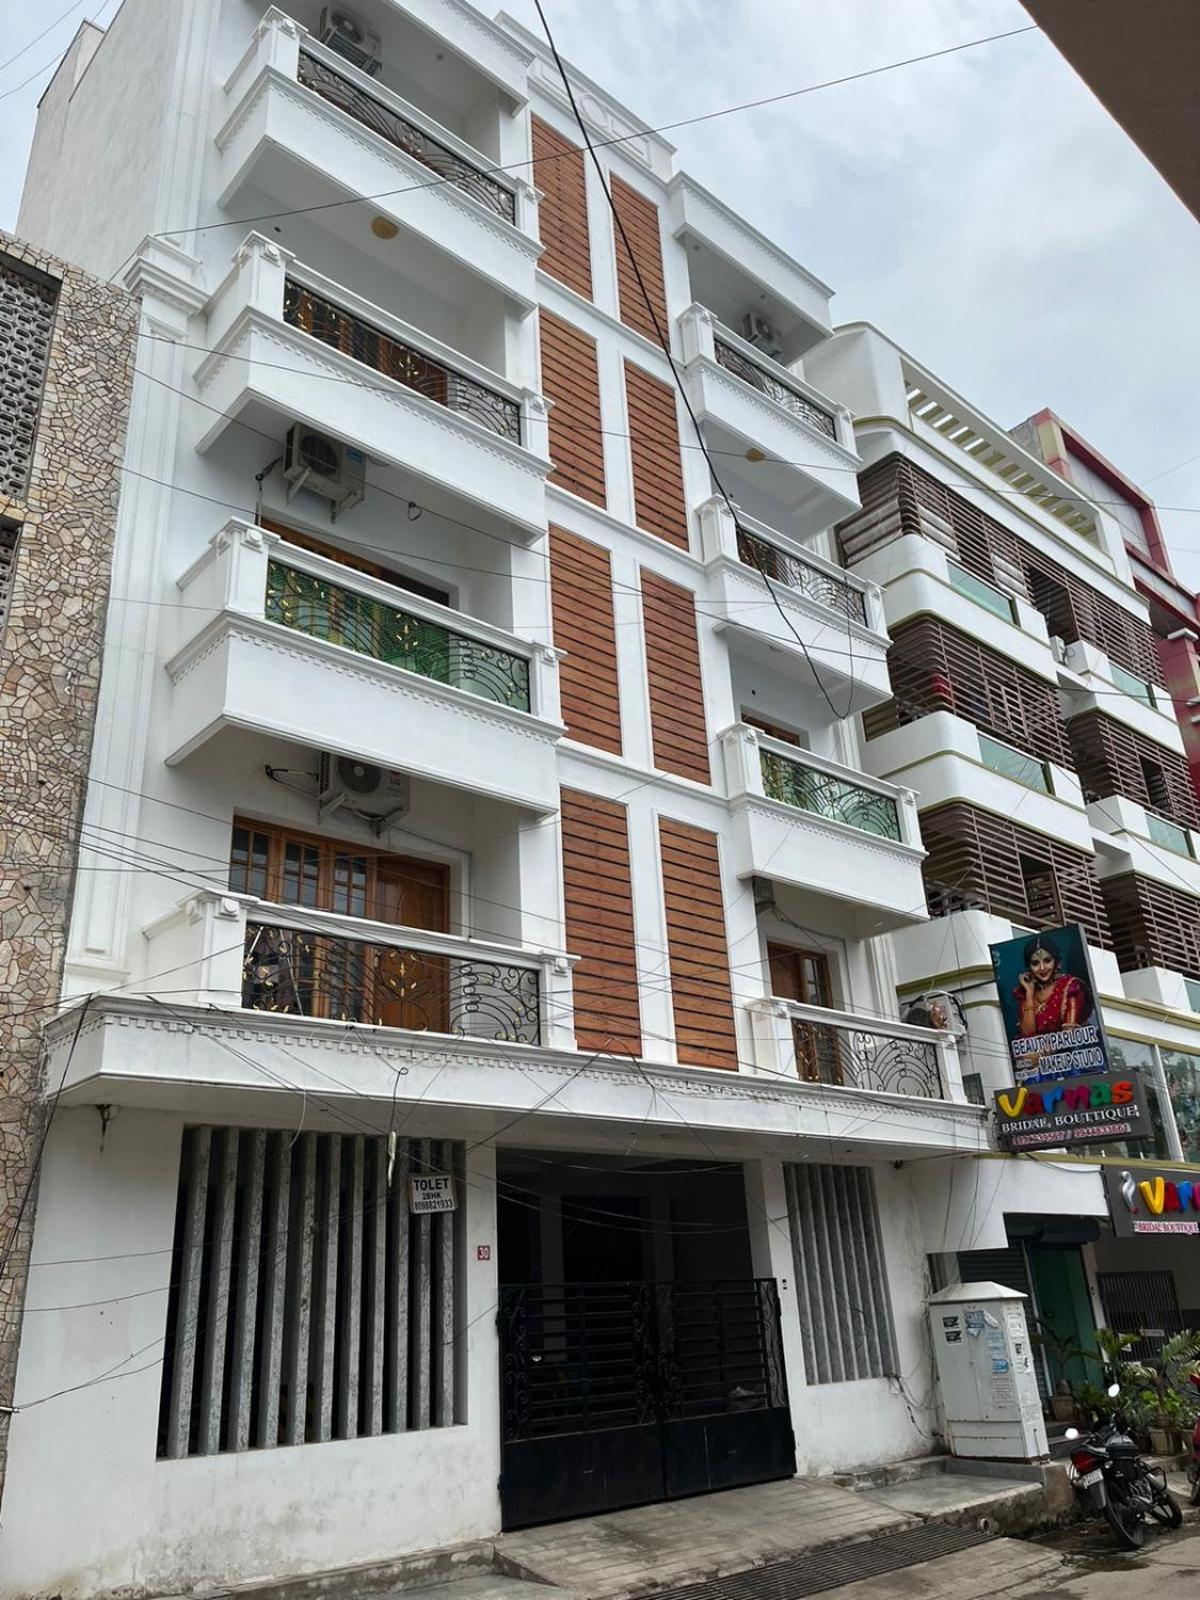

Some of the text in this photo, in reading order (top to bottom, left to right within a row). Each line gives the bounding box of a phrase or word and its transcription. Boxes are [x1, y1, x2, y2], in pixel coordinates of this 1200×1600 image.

[1012, 1026, 1098, 1057] BEAUTY PARLOUR
[1040, 1053, 1073, 1074] MAKEUP
[1072, 1047, 1104, 1069] STUDIO
[413, 1178, 449, 1191] TOLET
[1139, 1175, 1200, 1215] Var
[1137, 1221, 1162, 1232] BRIDAL
